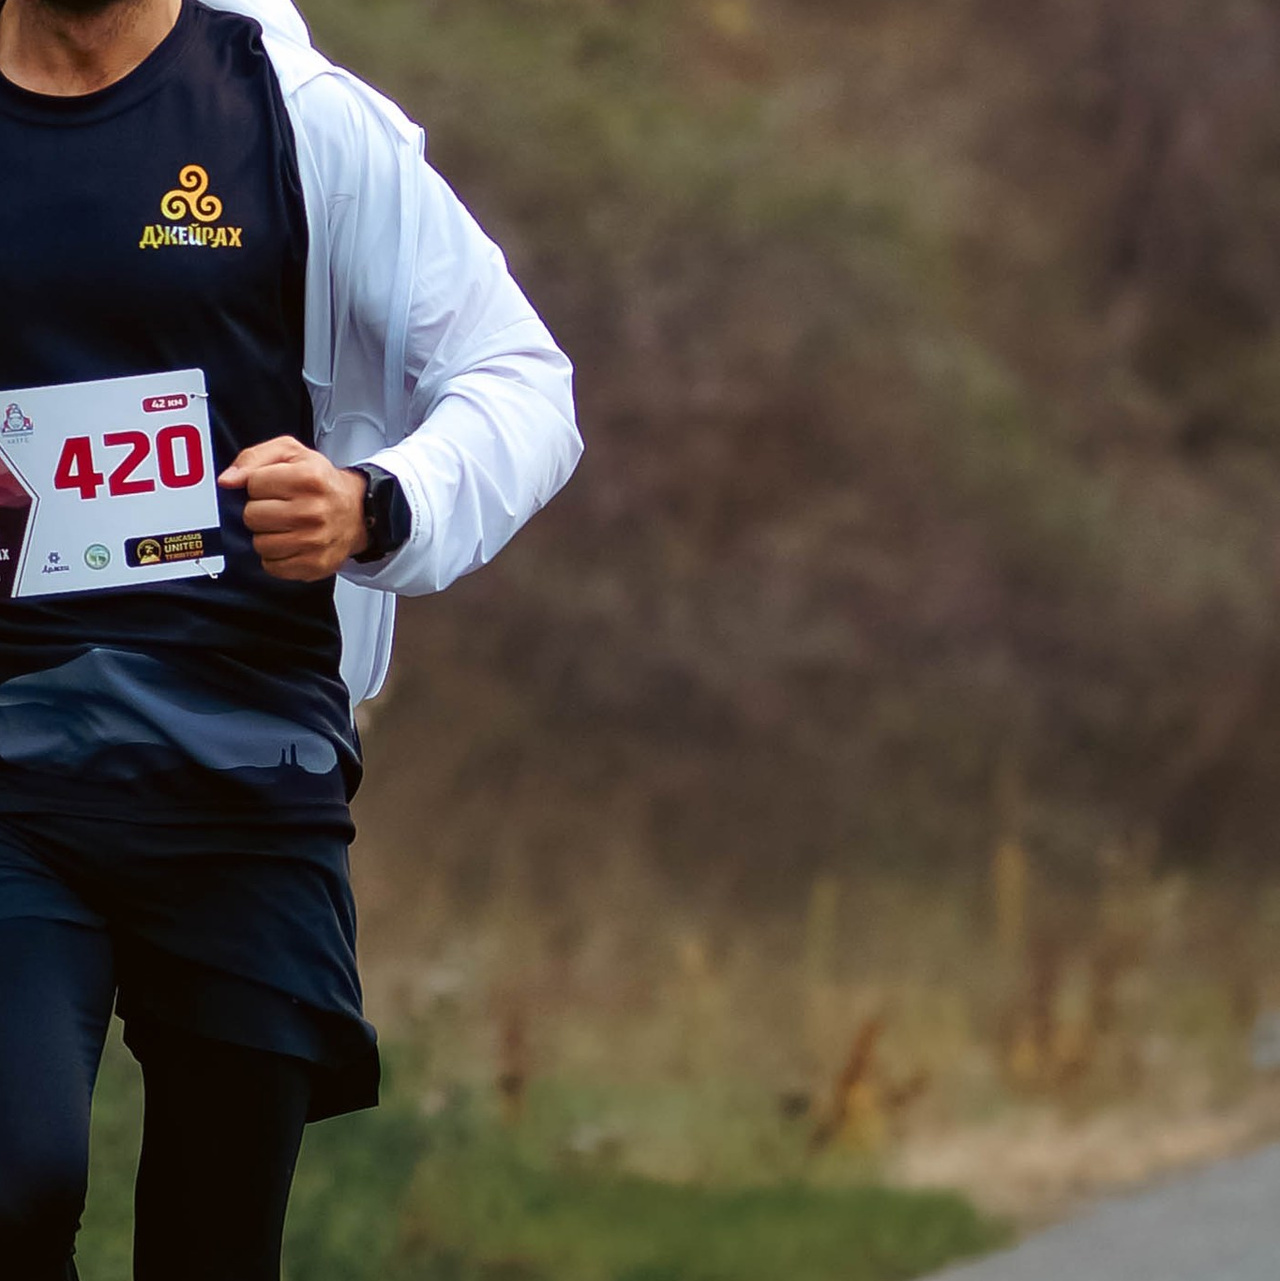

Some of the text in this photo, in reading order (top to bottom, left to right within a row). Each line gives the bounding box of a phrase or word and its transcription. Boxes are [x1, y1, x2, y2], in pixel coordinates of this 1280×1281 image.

[139, 223, 243, 250] ДЖЕЙРАХ
[151, 399, 166, 408] 42
[53, 423, 206, 500] 420
[163, 532, 202, 544] CAUCASUS
[164, 540, 203, 553] UNITED
